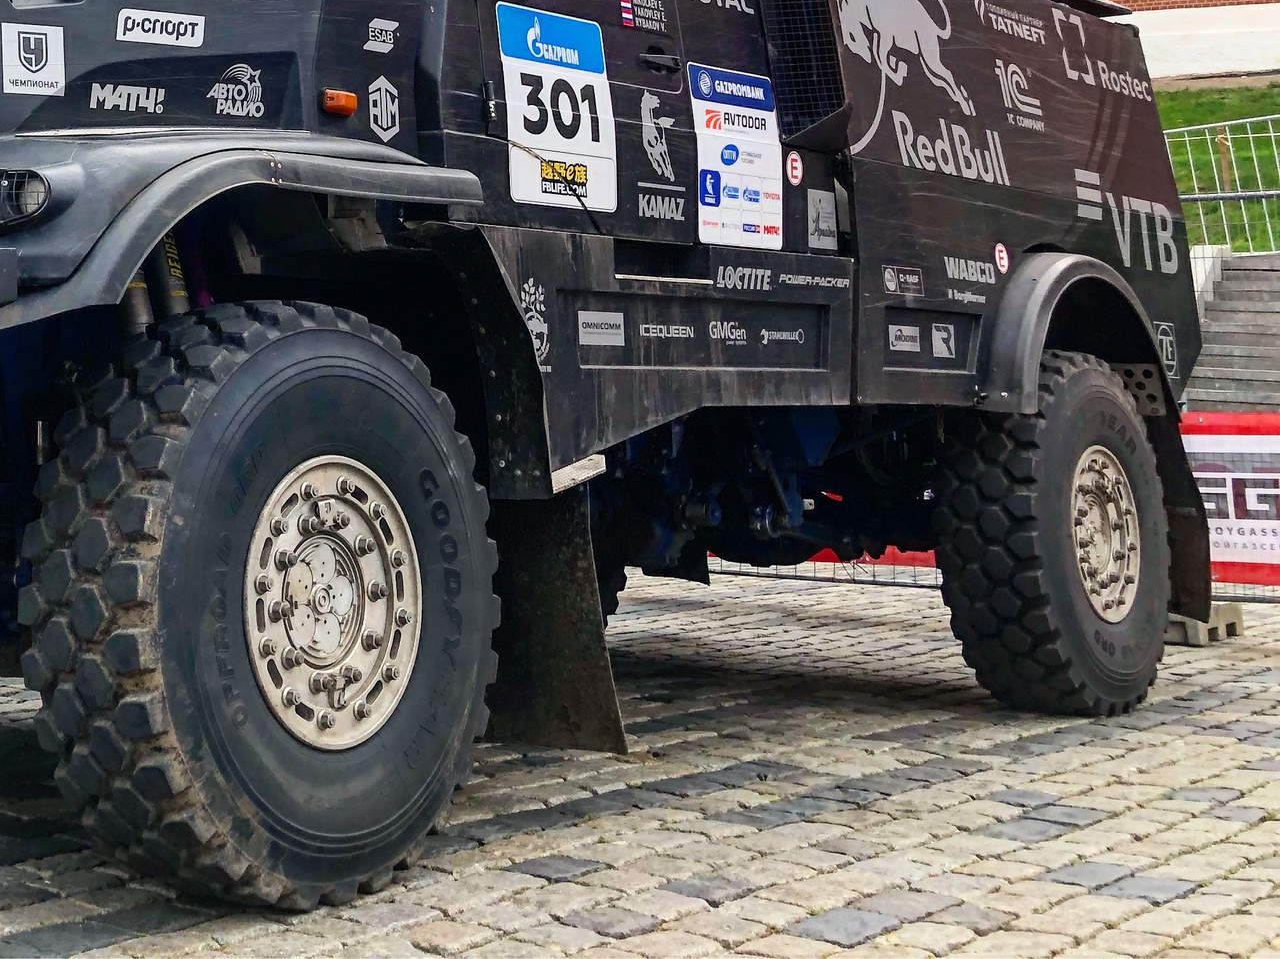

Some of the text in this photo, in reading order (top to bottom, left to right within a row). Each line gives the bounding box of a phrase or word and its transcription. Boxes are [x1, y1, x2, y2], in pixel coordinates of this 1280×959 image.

[368, 27, 394, 44] ESAB
[988, 13, 1045, 45] TATNEFT
[542, 44, 580, 66] GAZPROM
[9, 78, 60, 89] ЧЕМПИОНАТ
[715, 79, 766, 101] GAZPROMBANK
[1097, 59, 1152, 102] Rostec
[89, 82, 166, 114] МАТЧ!
[206, 82, 247, 99] АВТО
[216, 99, 265, 118] РАДИО
[519, 72, 601, 143] 301
[723, 112, 767, 131] AVTODOR
[1016, 115, 1045, 132] COMPANY
[542, 182, 587, 197] FBLIFE.COM
[638, 193, 686, 221] KAMAZ
[1105, 191, 1179, 275] VTB
[716, 265, 773, 291] LOCTITE
[943, 256, 996, 284] WABCO
[779, 274, 850, 288] POWER-PACKER
[581, 321, 621, 331] OMNICOMM
[639, 324, 695, 339] ICEQUEEN
[709, 321, 747, 340] GMGen
[1209, 526, 1279, 538] OYGASS
[1213, 540, 1280, 551] ОЙГАЗСЕ
